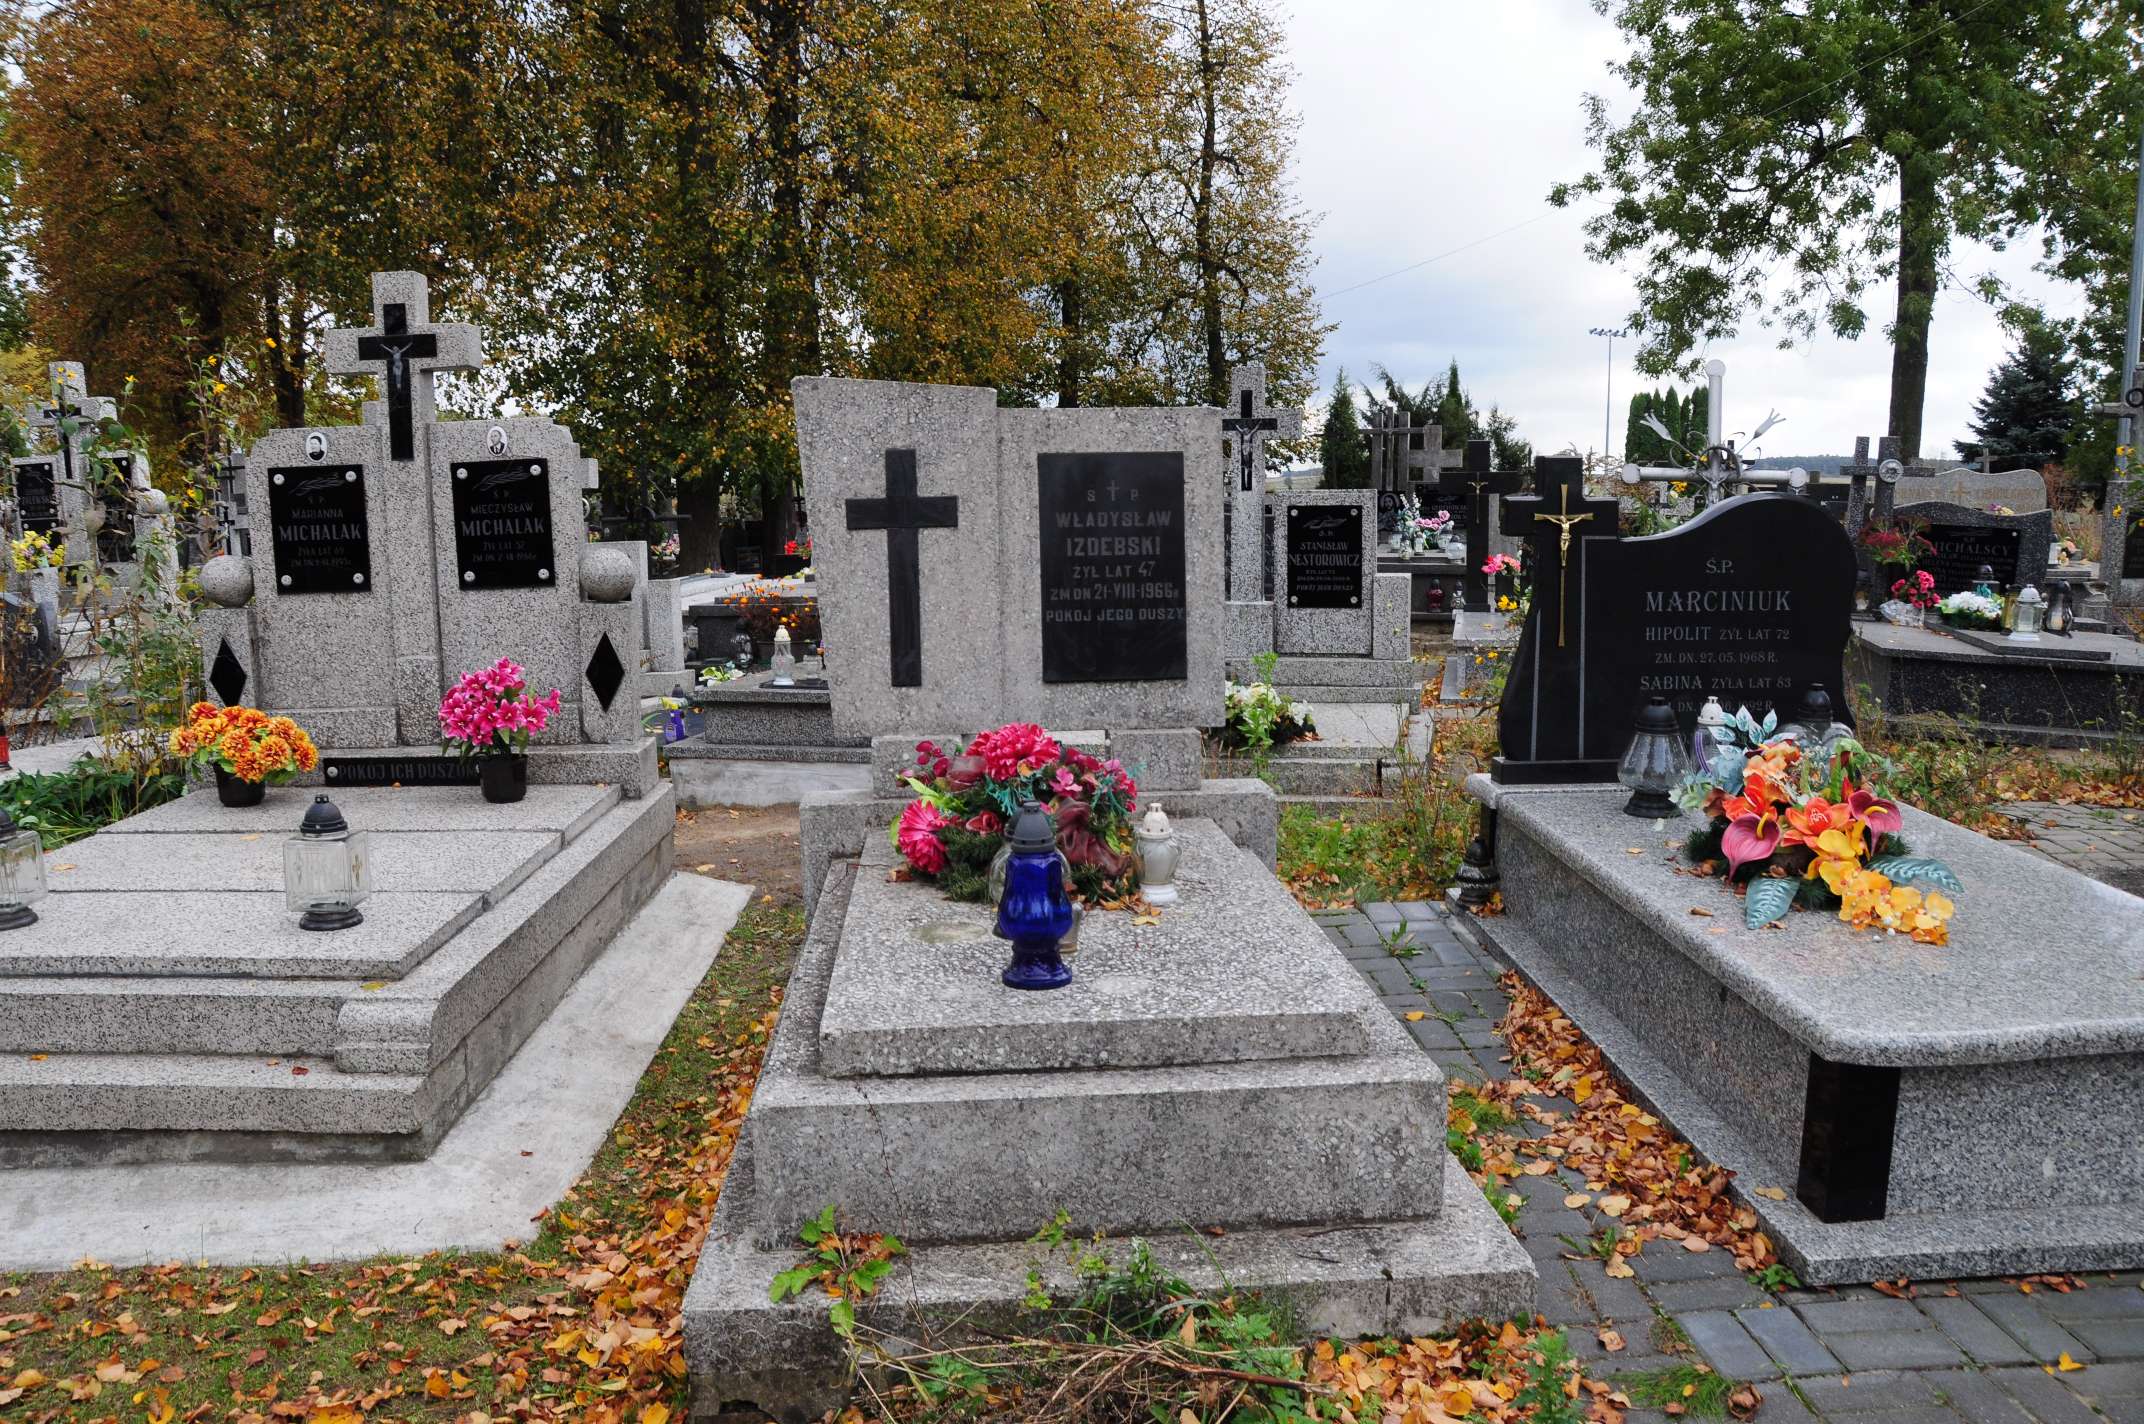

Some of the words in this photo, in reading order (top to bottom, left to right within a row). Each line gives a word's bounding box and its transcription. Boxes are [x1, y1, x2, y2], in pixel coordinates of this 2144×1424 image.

[290, 508, 344, 520] MARIANNA
[1055, 510, 1172, 528] WŁADYSŁAW
[278, 523, 362, 542] MICHALAK
[461, 517, 545, 537] MICHALAK
[1066, 536, 1161, 557] IZDEBSKI
[1935, 541, 2009, 557] ICHALSCY
[1288, 553, 1360, 567] NESTOROWICZ
[1105, 565, 1132, 578] LAT
[1138, 561, 1155, 577] 47
[1645, 590, 1792, 613] MARCINIUK
[1097, 608, 1134, 622] JEGO
[1139, 607, 1184, 621] DUSZY
[1645, 626, 1712, 641] HIPOLIT
[1748, 628, 1771, 640] LAT
[1777, 628, 1790, 640] 72
[1640, 675, 1703, 690] SABINA
[1749, 677, 1771, 689] LAT
[390, 763, 414, 780] ICH
